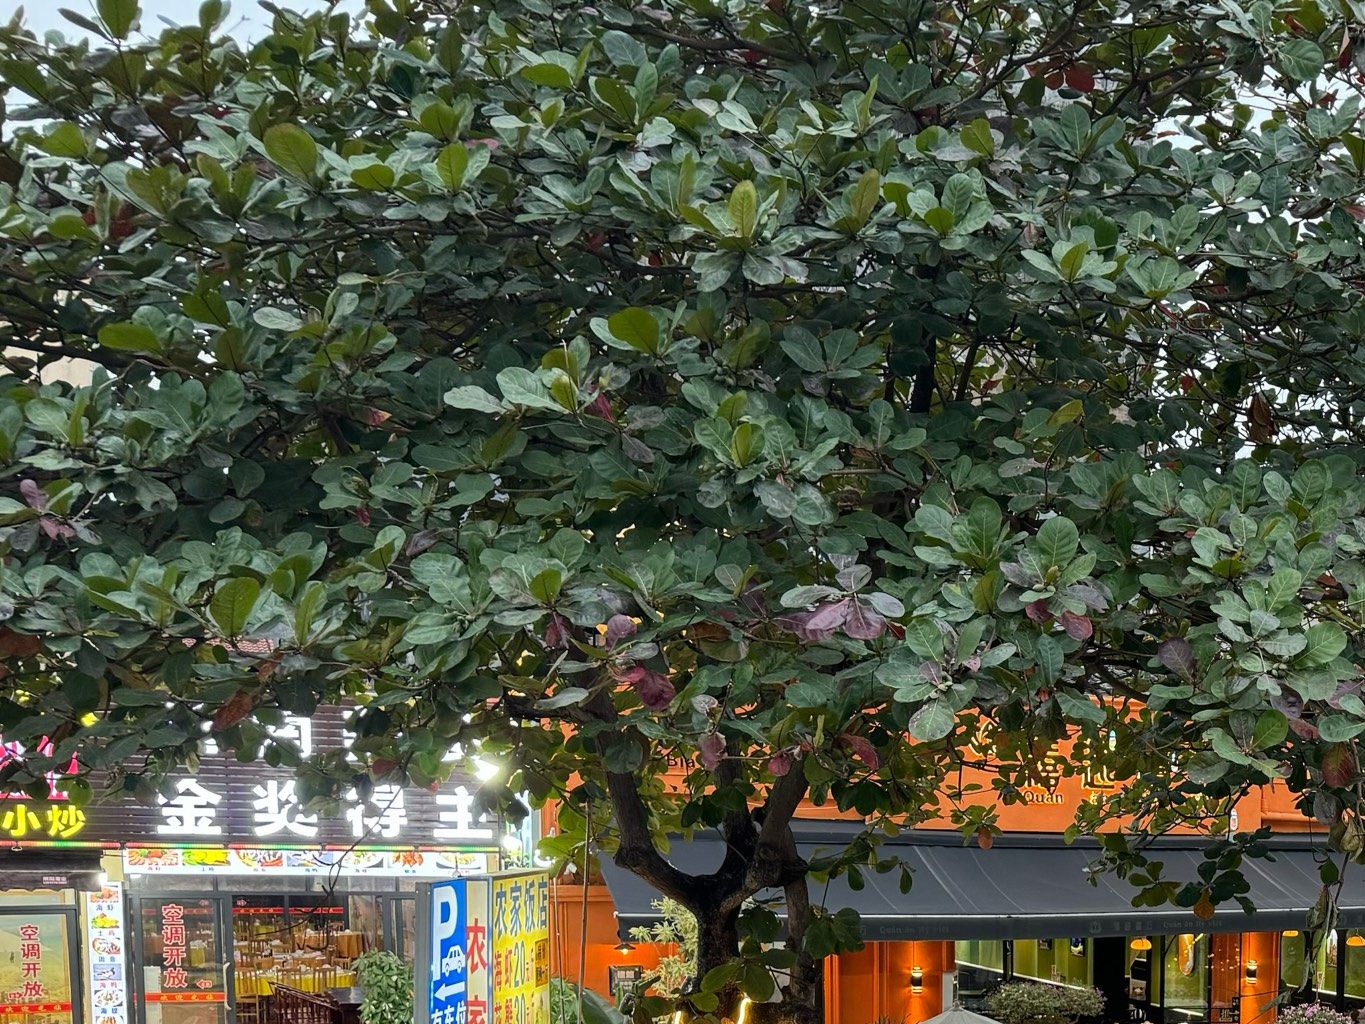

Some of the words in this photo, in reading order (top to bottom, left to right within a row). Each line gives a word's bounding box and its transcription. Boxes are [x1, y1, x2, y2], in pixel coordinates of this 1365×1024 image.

[2, 804, 86, 838] 小炒
[157, 777, 493, 839] 金奖得主
[433, 886, 458, 981] P
[495, 876, 548, 940] 农家饭店
[19, 924, 44, 999] 空调开放
[161, 903, 188, 988] 空调开放
